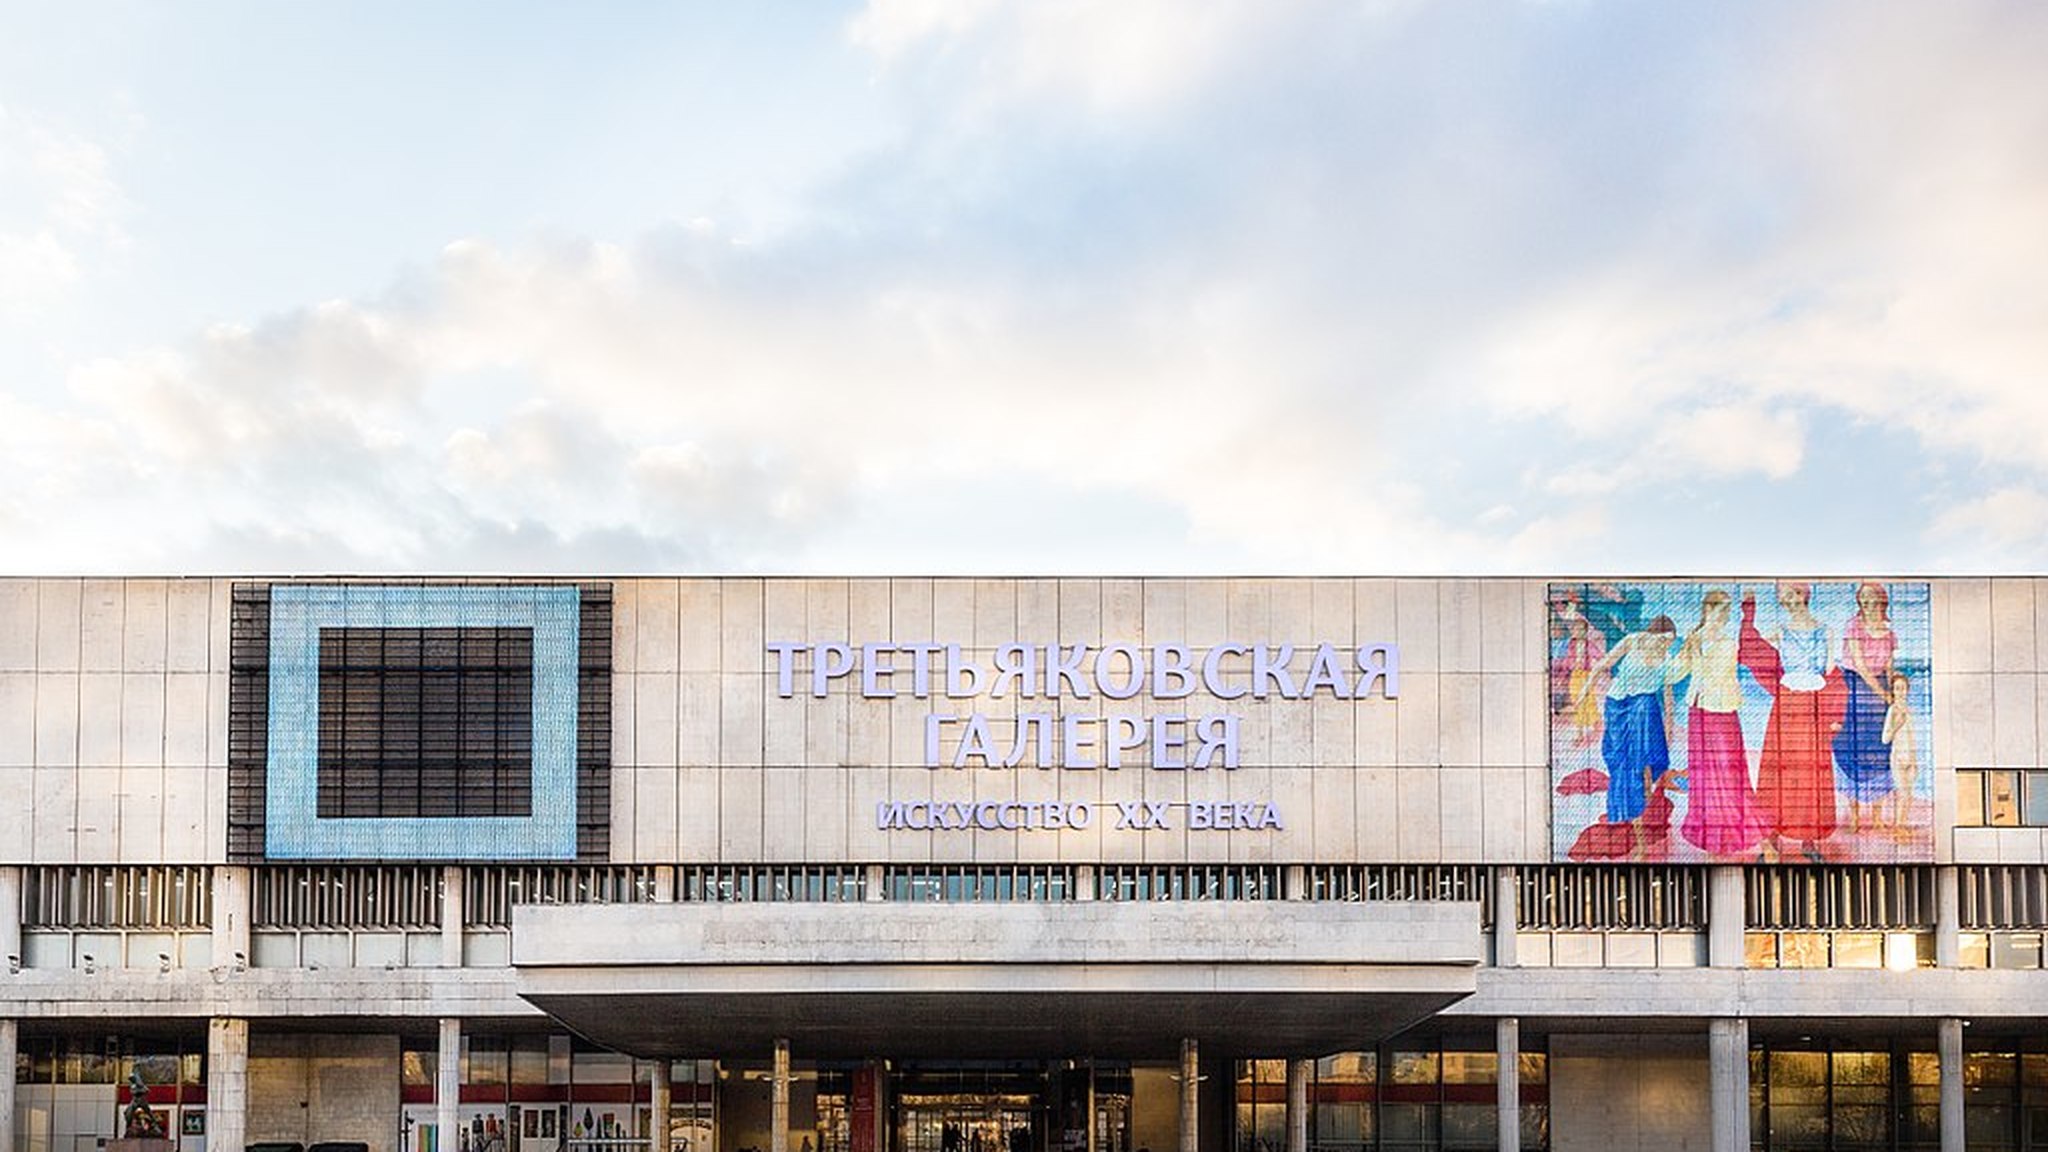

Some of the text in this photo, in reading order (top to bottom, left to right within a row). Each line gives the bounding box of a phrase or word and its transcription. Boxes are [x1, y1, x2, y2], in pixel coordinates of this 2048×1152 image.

[767, 642, 1400, 699] ТРЕТЬЯКОВСКАЯ
[925, 713, 1242, 769] ГАЛЕРЕЯ
[877, 801, 1092, 831] ИСКУССТВО
[1189, 801, 1283, 831] ВЕКА
